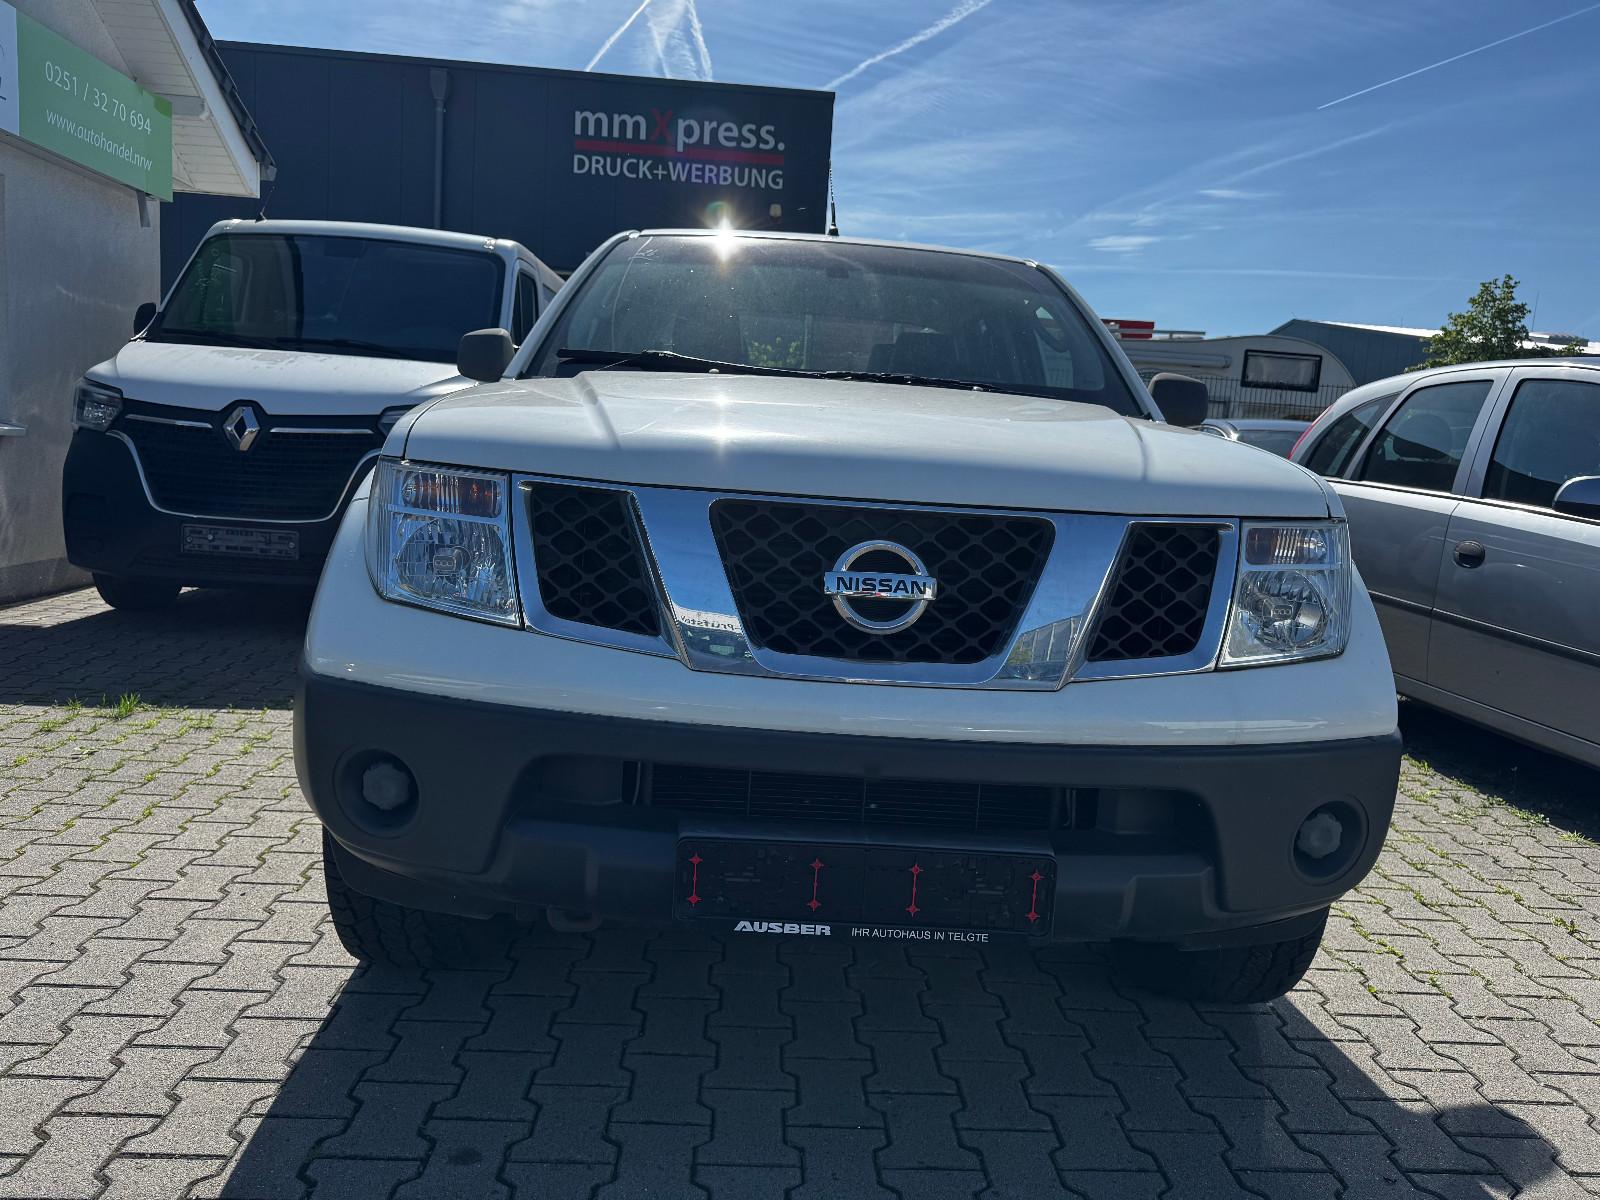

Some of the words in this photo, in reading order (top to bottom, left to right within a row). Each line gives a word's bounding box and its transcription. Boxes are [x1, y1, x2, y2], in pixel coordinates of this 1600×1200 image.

[45, 61, 77, 96] 0251
[83, 82, 89, 101] /
[93, 87, 108, 112] 32
[112, 98, 127, 121] 70
[130, 110, 152, 135] 694
[46, 109, 153, 171] www.autohandel.nrw
[574, 108, 785, 152] mmXpress.
[573, 154, 784, 189] DRUCK+WERBUNG
[836, 576, 927, 595] NISSAN
[734, 920, 831, 936] AUSBER
[851, 927, 870, 937] IHR
[871, 928, 932, 940] AUTOHAUS
[934, 931, 945, 941] IN
[947, 932, 989, 943] TELGTE
